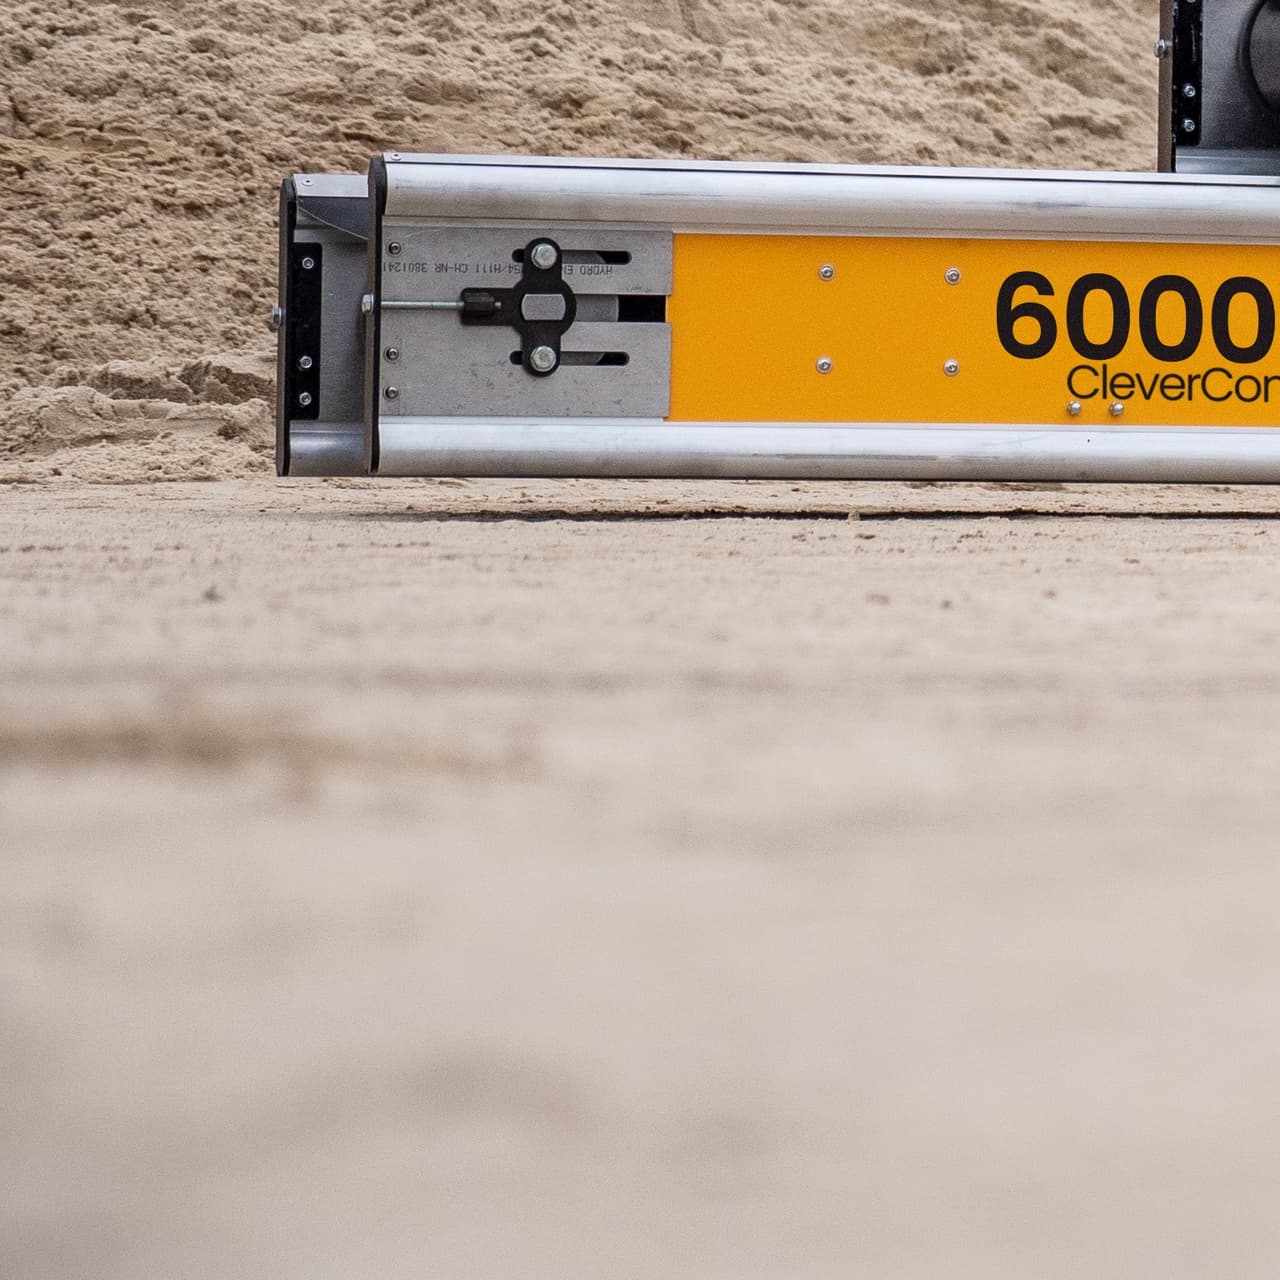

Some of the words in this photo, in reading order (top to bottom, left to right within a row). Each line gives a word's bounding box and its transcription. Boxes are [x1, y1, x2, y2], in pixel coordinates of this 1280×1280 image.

[434, 262, 468, 274] CH-NR
[579, 264, 613, 276] HYDRO
[996, 270, 1276, 364] 6000
